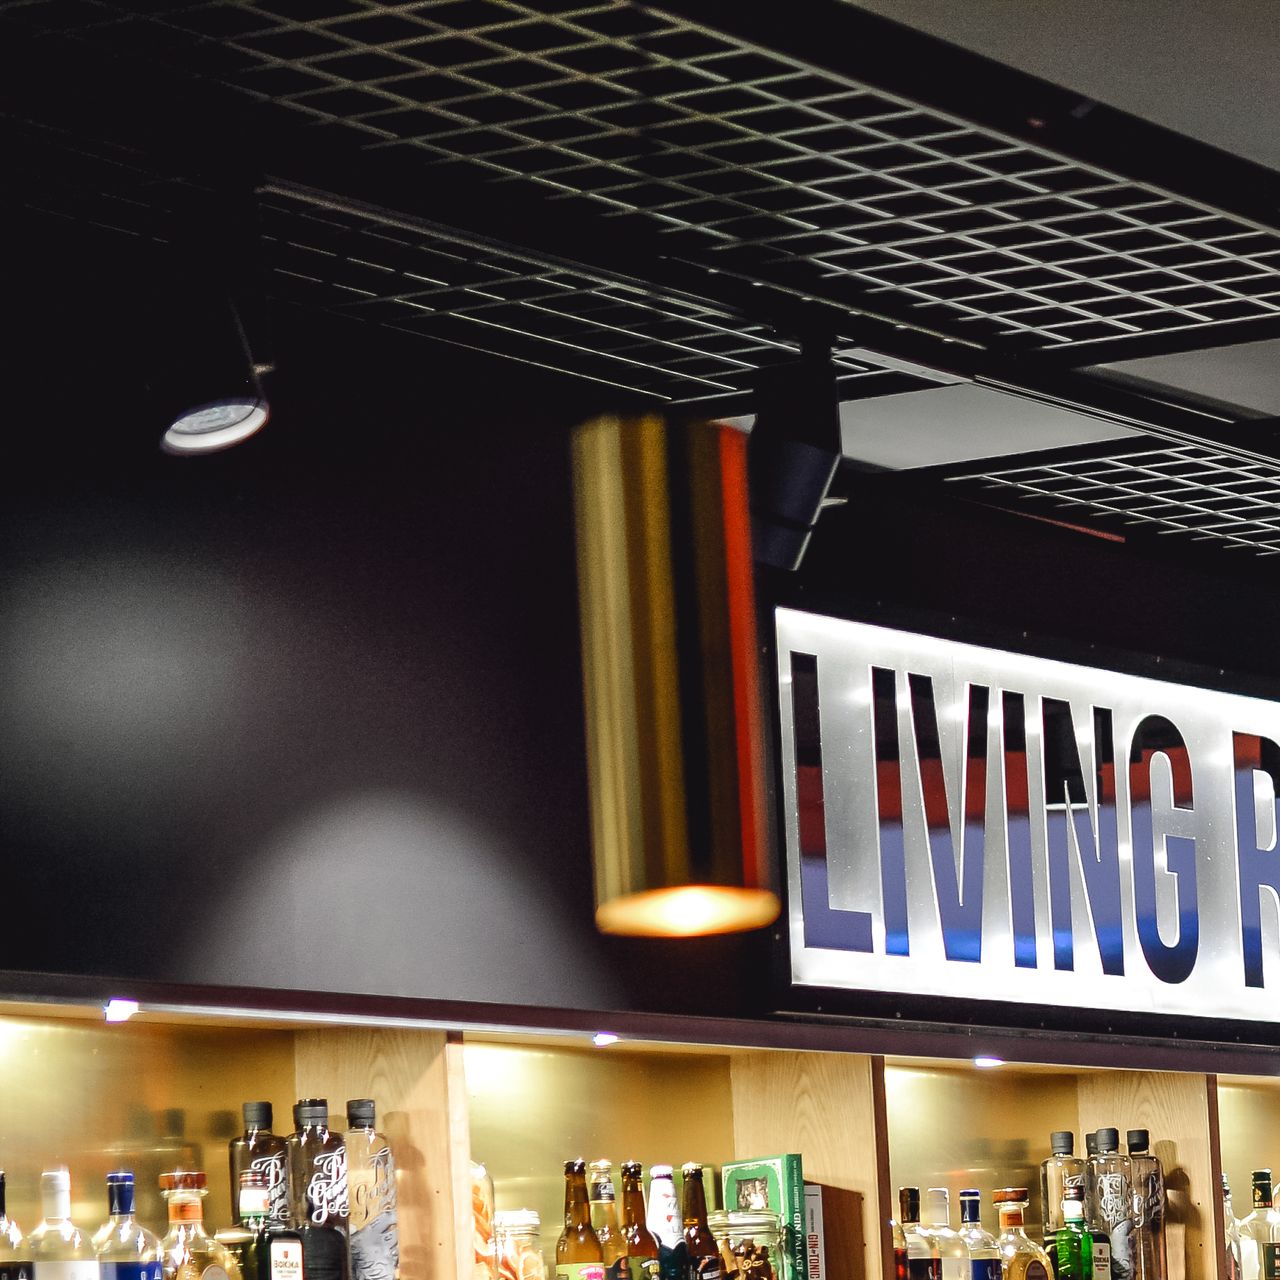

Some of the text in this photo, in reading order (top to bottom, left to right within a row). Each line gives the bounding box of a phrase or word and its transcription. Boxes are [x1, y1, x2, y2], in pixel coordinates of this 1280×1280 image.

[790, 651, 1201, 985] LIVING
[808, 1234, 819, 1249] GIN
[808, 1253, 821, 1280] TONIC
